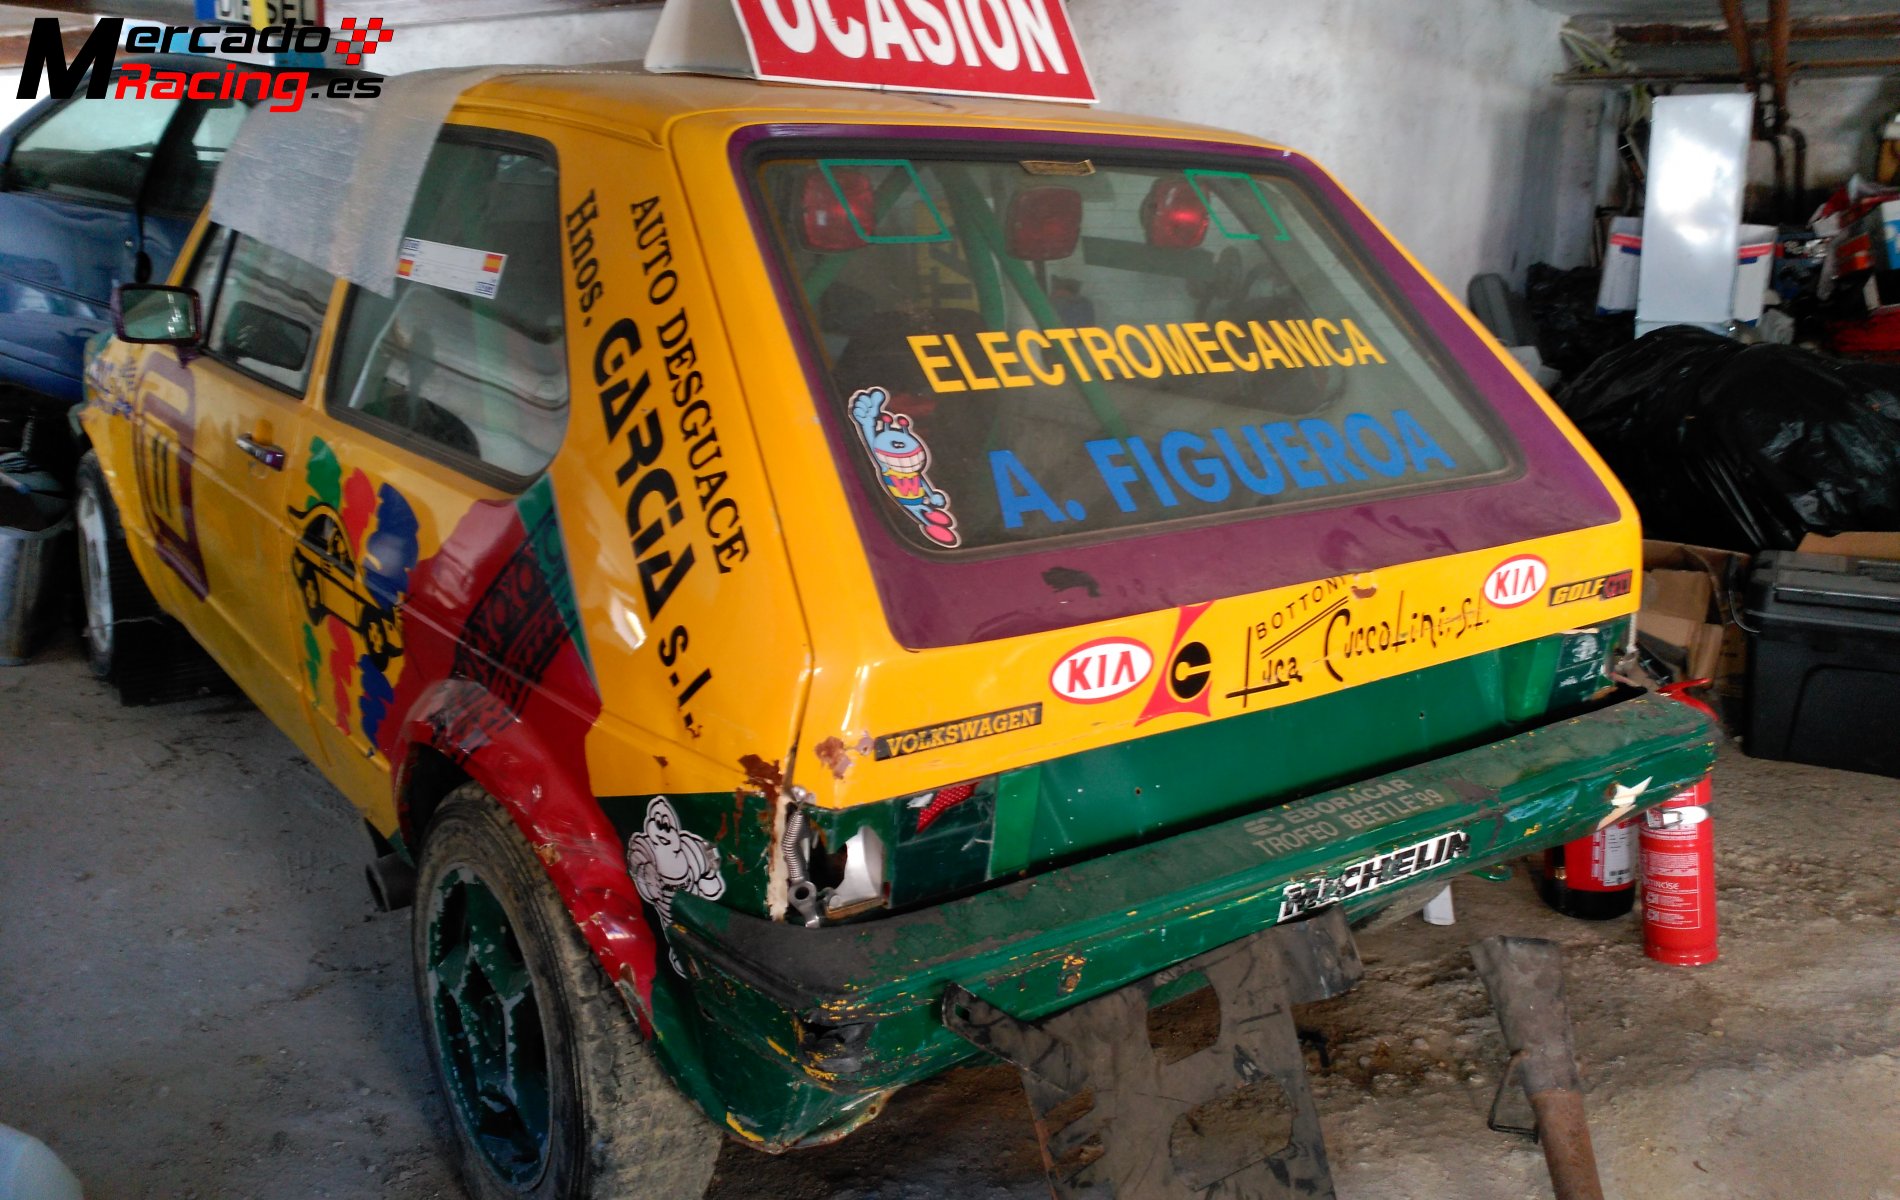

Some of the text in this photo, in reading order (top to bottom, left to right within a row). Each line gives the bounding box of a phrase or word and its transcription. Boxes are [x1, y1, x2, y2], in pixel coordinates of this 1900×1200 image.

[906, 318, 1387, 393] ELECTROMECANICA
[630, 195, 750, 574] AUTO DESGUACE
[988, 410, 1457, 529] A. FIGUEROA
[1493, 565, 1536, 600] KIA
[1551, 578, 1607, 605] GOLF
[1067, 650, 1136, 694] KIA
[886, 707, 1038, 757] VOLKSWAGEN
[1281, 778, 1414, 826] EBORACAR
[1252, 820, 1339, 857] TROFEO
